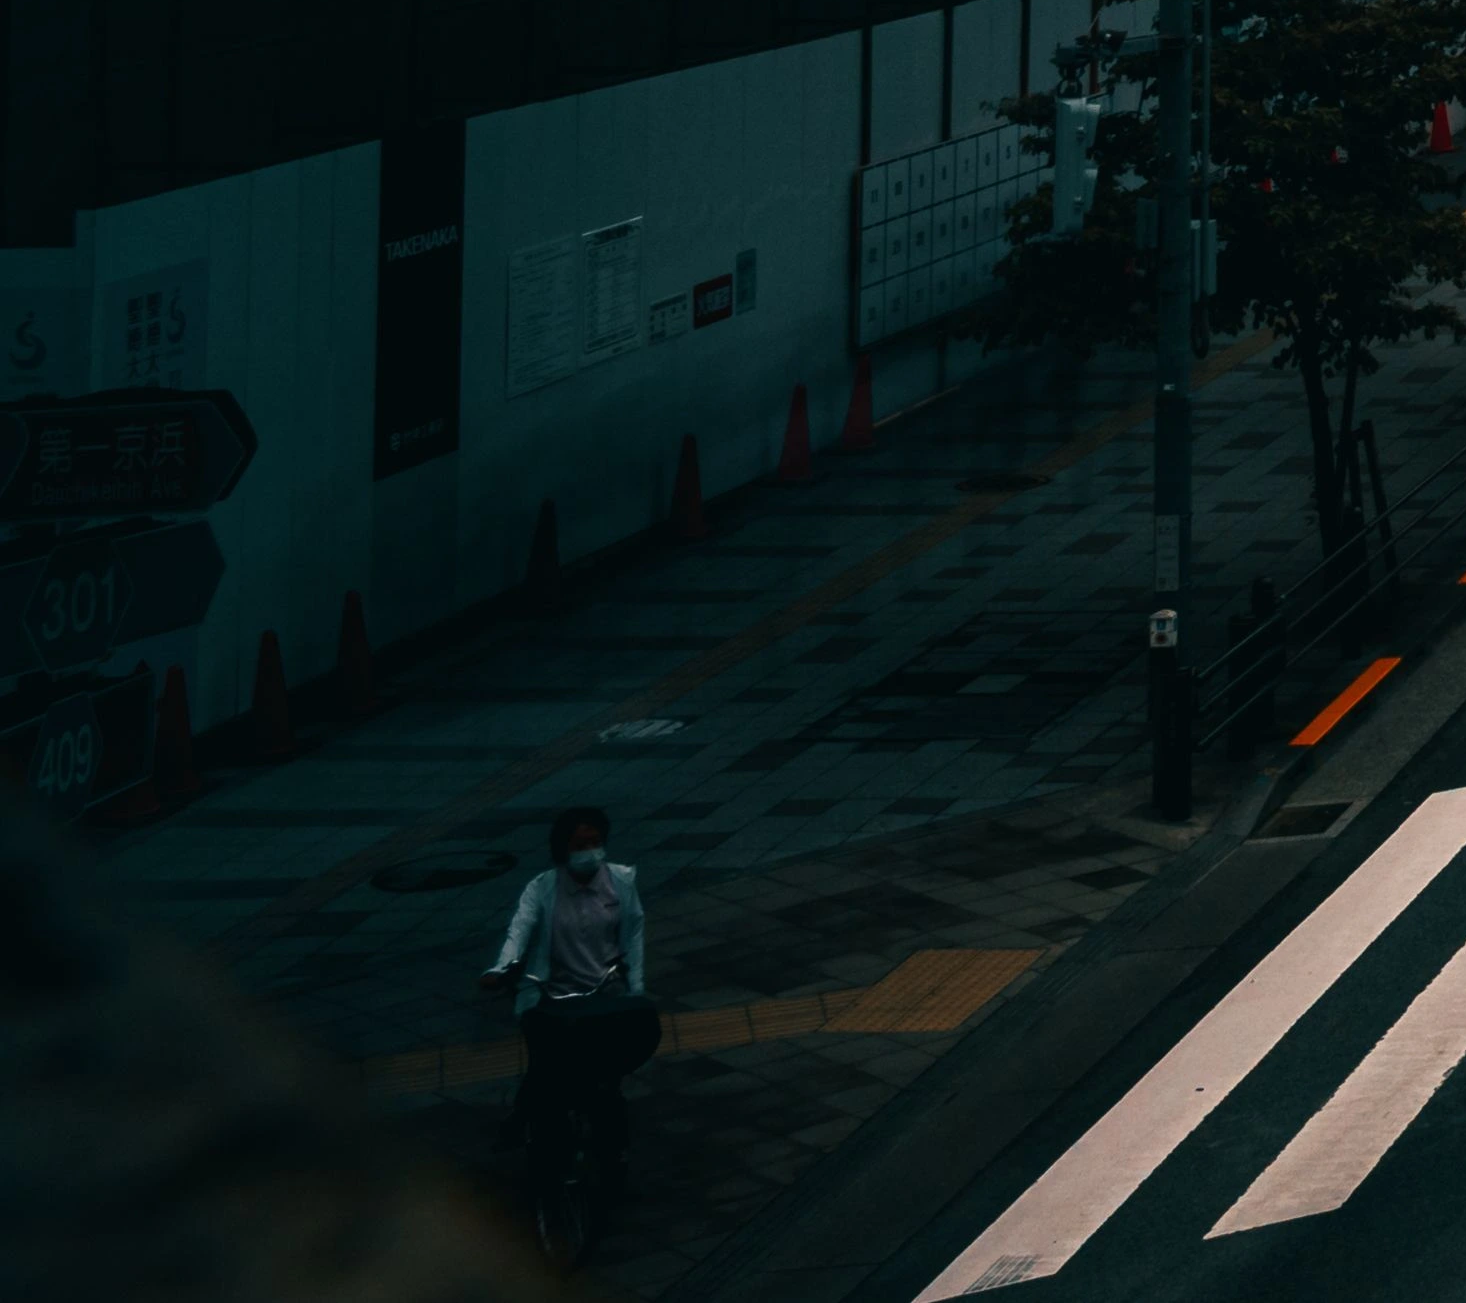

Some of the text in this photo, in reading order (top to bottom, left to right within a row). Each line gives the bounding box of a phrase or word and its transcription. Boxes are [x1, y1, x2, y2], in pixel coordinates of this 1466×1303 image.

[384, 225, 459, 263] TAKENAKA
[38, 420, 185, 474] 第一京浜
[41, 562, 117, 641] 301
[36, 723, 93, 793] 409
